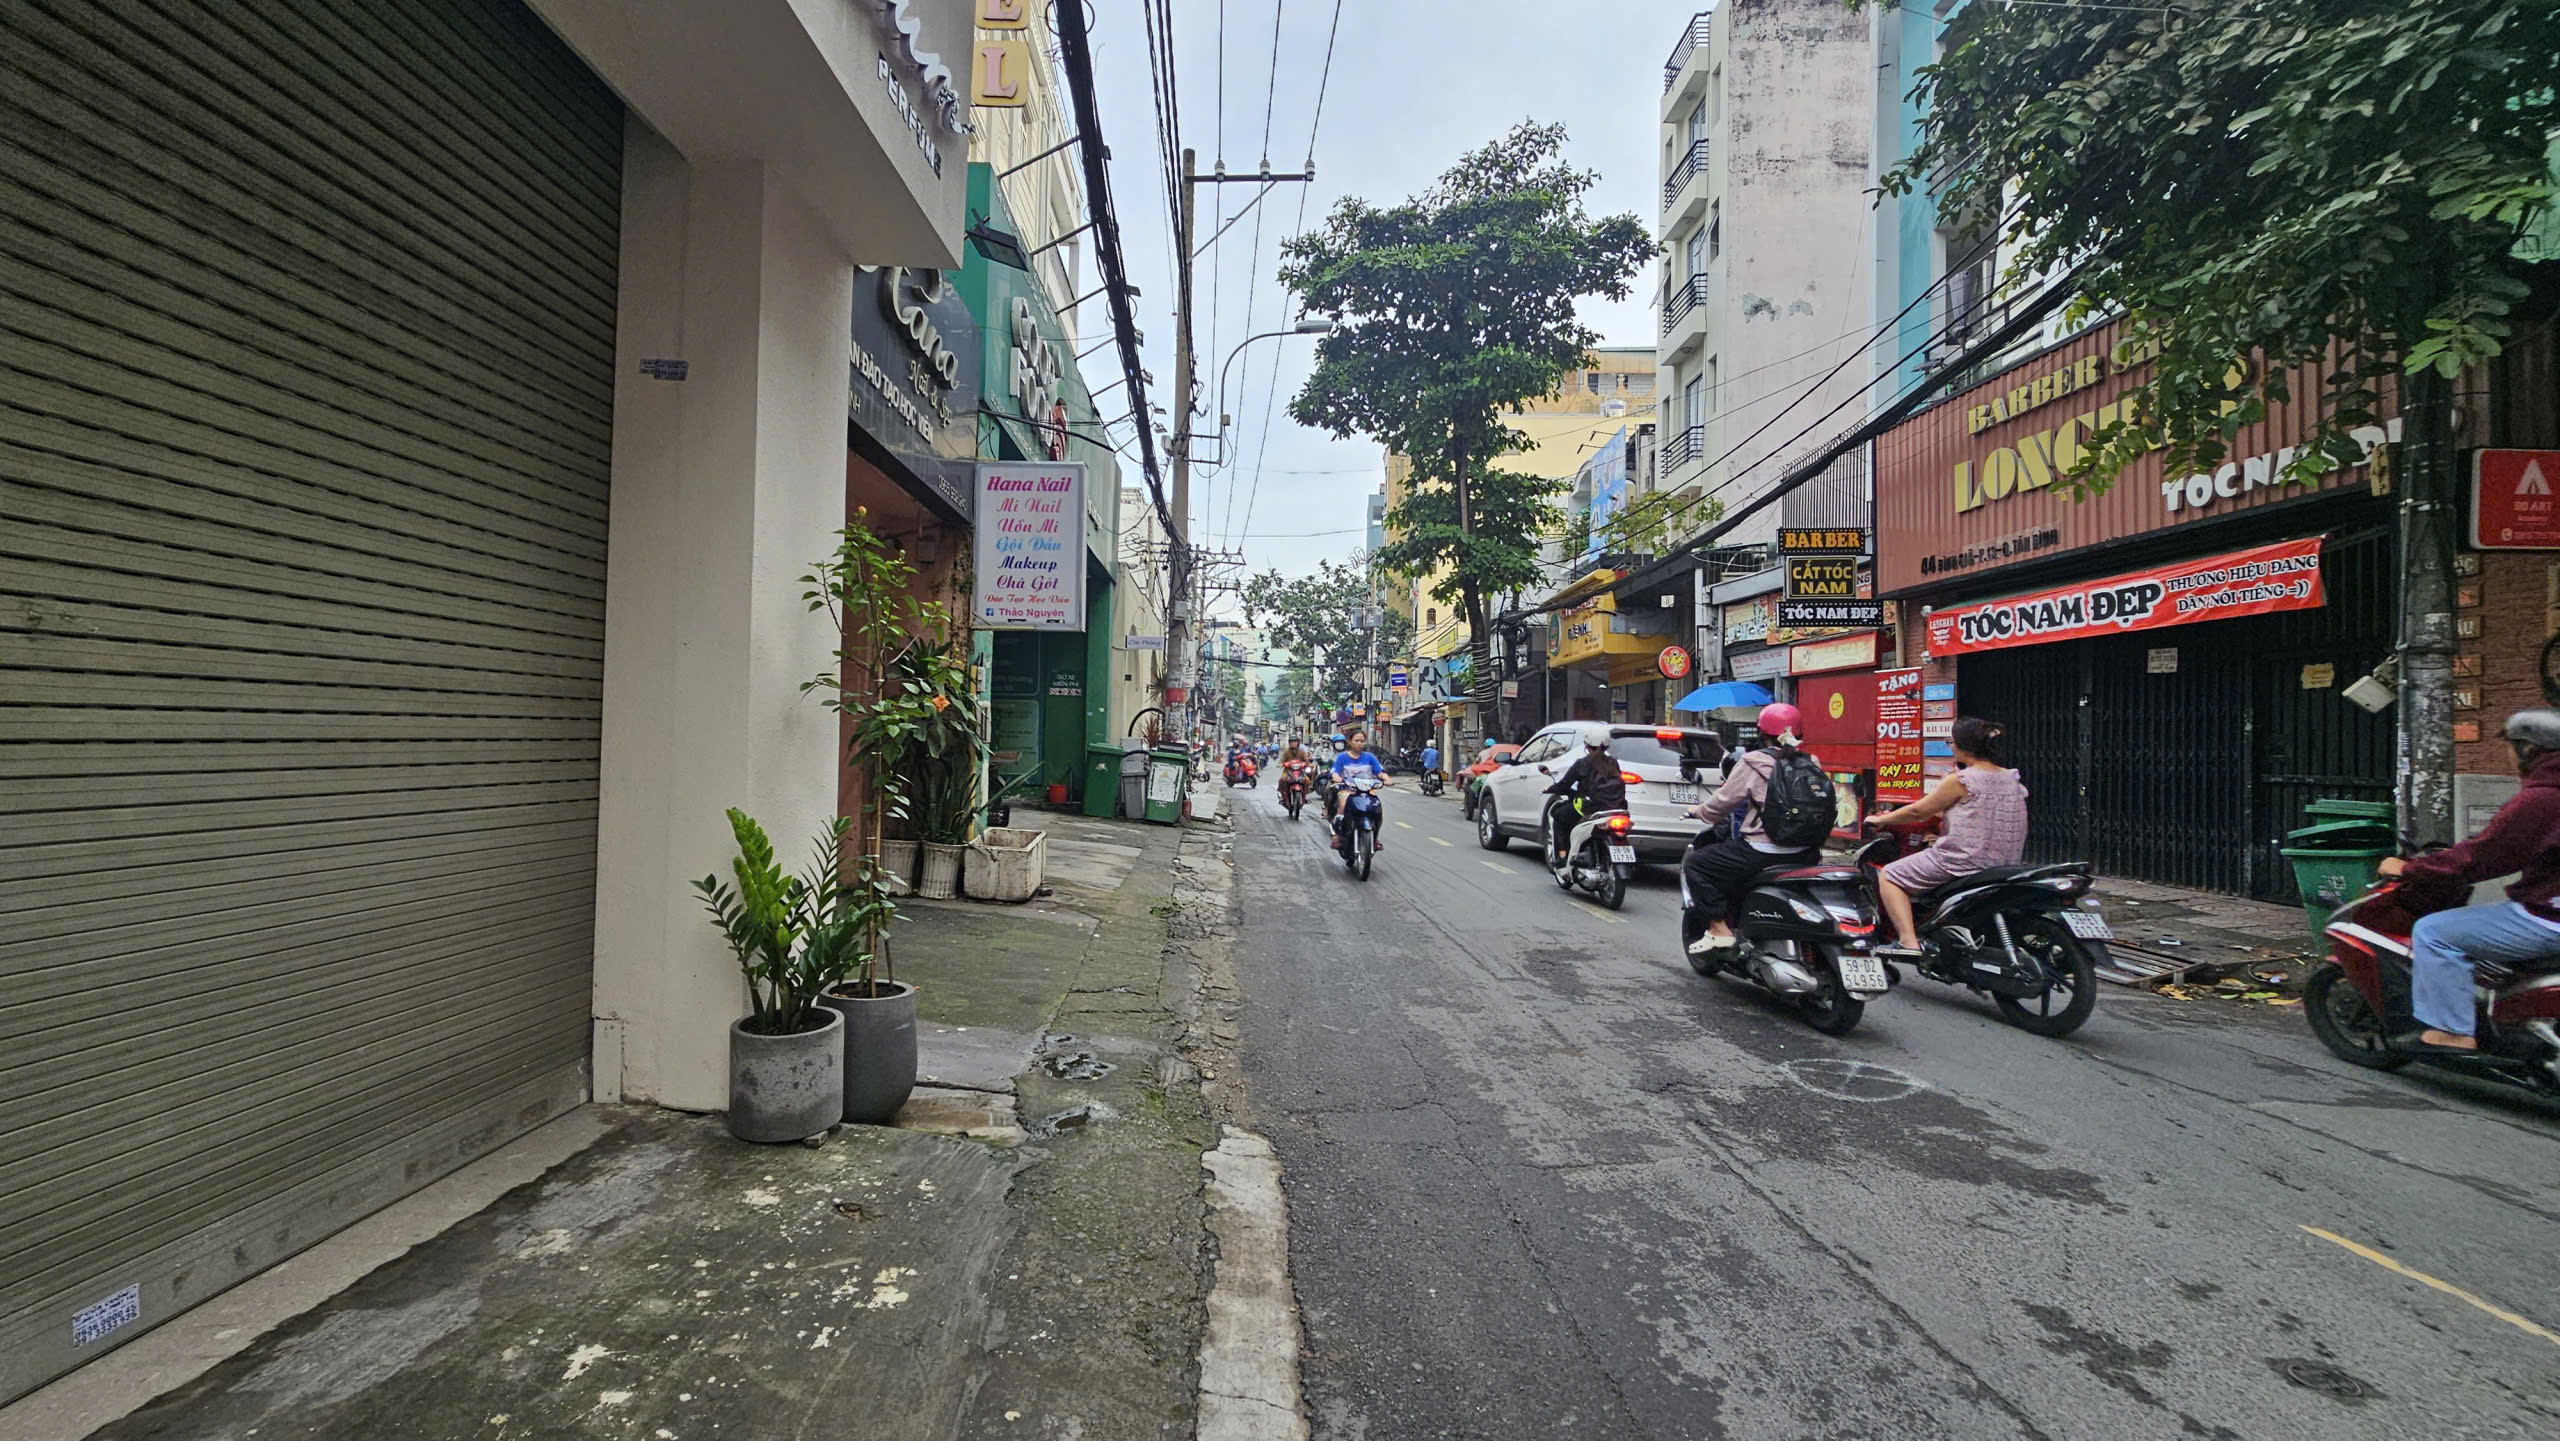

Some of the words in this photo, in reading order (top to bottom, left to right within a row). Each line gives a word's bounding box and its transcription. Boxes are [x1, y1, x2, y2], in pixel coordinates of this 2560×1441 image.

[877, 52, 942, 180] PERFUME
[909, 360, 931, 398] Nail
[1968, 354, 2102, 436] BARBER
[986, 476, 1034, 491] Hana
[1036, 476, 1072, 492] Nail
[1024, 497, 1062, 513] Nail
[997, 518, 1032, 533] Uốn
[1784, 532, 1860, 549] BARBER
[998, 555, 1058, 573] Makeup
[1792, 560, 1821, 579] CẮT
[1823, 562, 1852, 579] TÓC
[1921, 554, 1937, 576] 44
[2167, 569, 2227, 592] THƯƠNG
[2228, 562, 2269, 581] HIỆU
[2270, 554, 2318, 573] ĐANG
[996, 574, 1026, 590] Chà
[1031, 575, 1059, 592] Gót
[1800, 581, 1847, 594] NAM
[2209, 587, 2237, 606] NỔI
[2238, 582, 2285, 602] TIẾNG
[999, 607, 1024, 616] Thảo
[1785, 603, 1814, 620] TÓC
[1816, 607, 1848, 619] NAM
[1850, 606, 1879, 622] ĐẸP
[1960, 606, 2013, 641] TÓC
[2015, 596, 2085, 634] NAM
[2090, 582, 2164, 625] ĐẸP
[1879, 671, 1919, 692] TẶNG
[1877, 722, 1900, 739] 90
[1903, 763, 1921, 774] TAI
